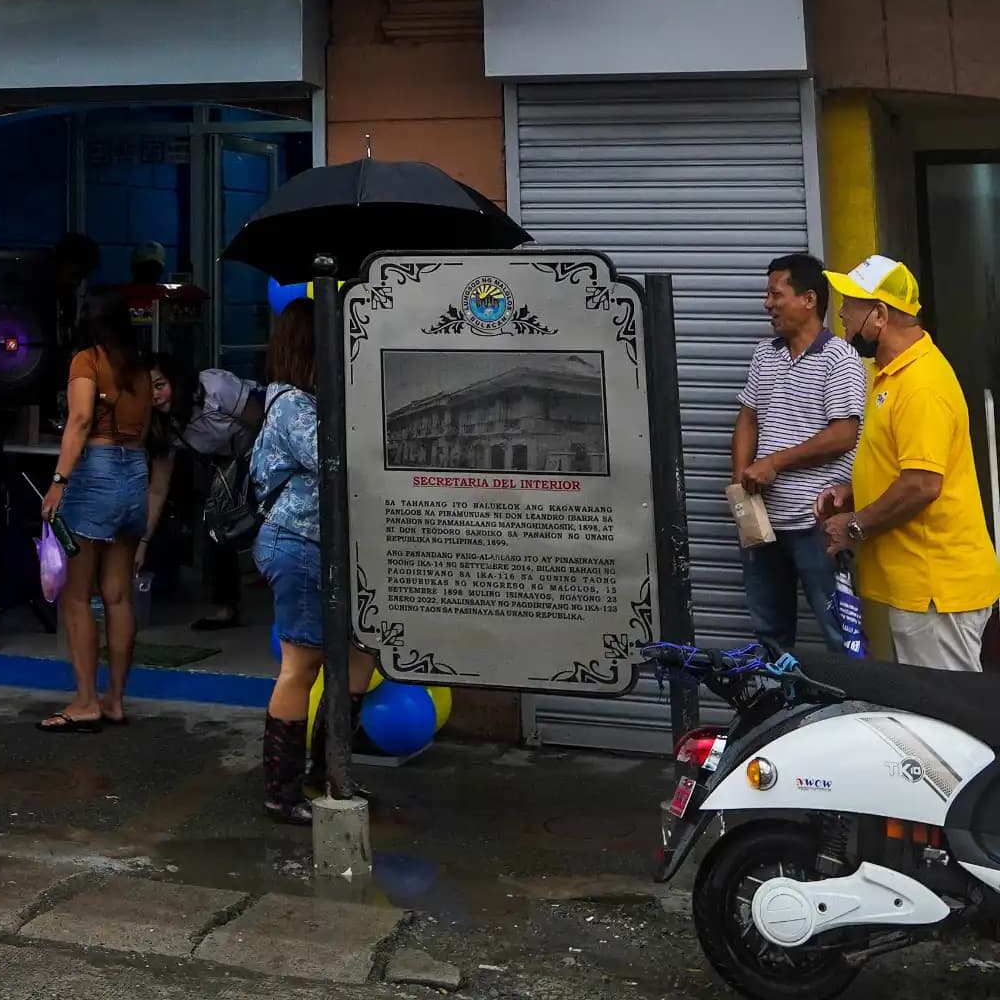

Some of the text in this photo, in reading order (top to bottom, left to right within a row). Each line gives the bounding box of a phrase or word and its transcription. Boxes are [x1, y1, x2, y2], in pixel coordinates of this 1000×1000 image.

[413, 476, 581, 490] SECRETARIA DEL INTERIOR
[401, 500, 447, 508] TAHANANG
[549, 505, 613, 513] KAGAWARANG
[437, 520, 496, 528] PAMAHALAANG
[406, 551, 452, 559] PANANDANG
[524, 555, 538, 563] ITO
[388, 568, 453, 577] PAGDIRIWANG
[550, 584, 599, 593] MALOLOS,
[388, 595, 415, 603] ENERO
[560, 594, 601, 602] NGAYONG
